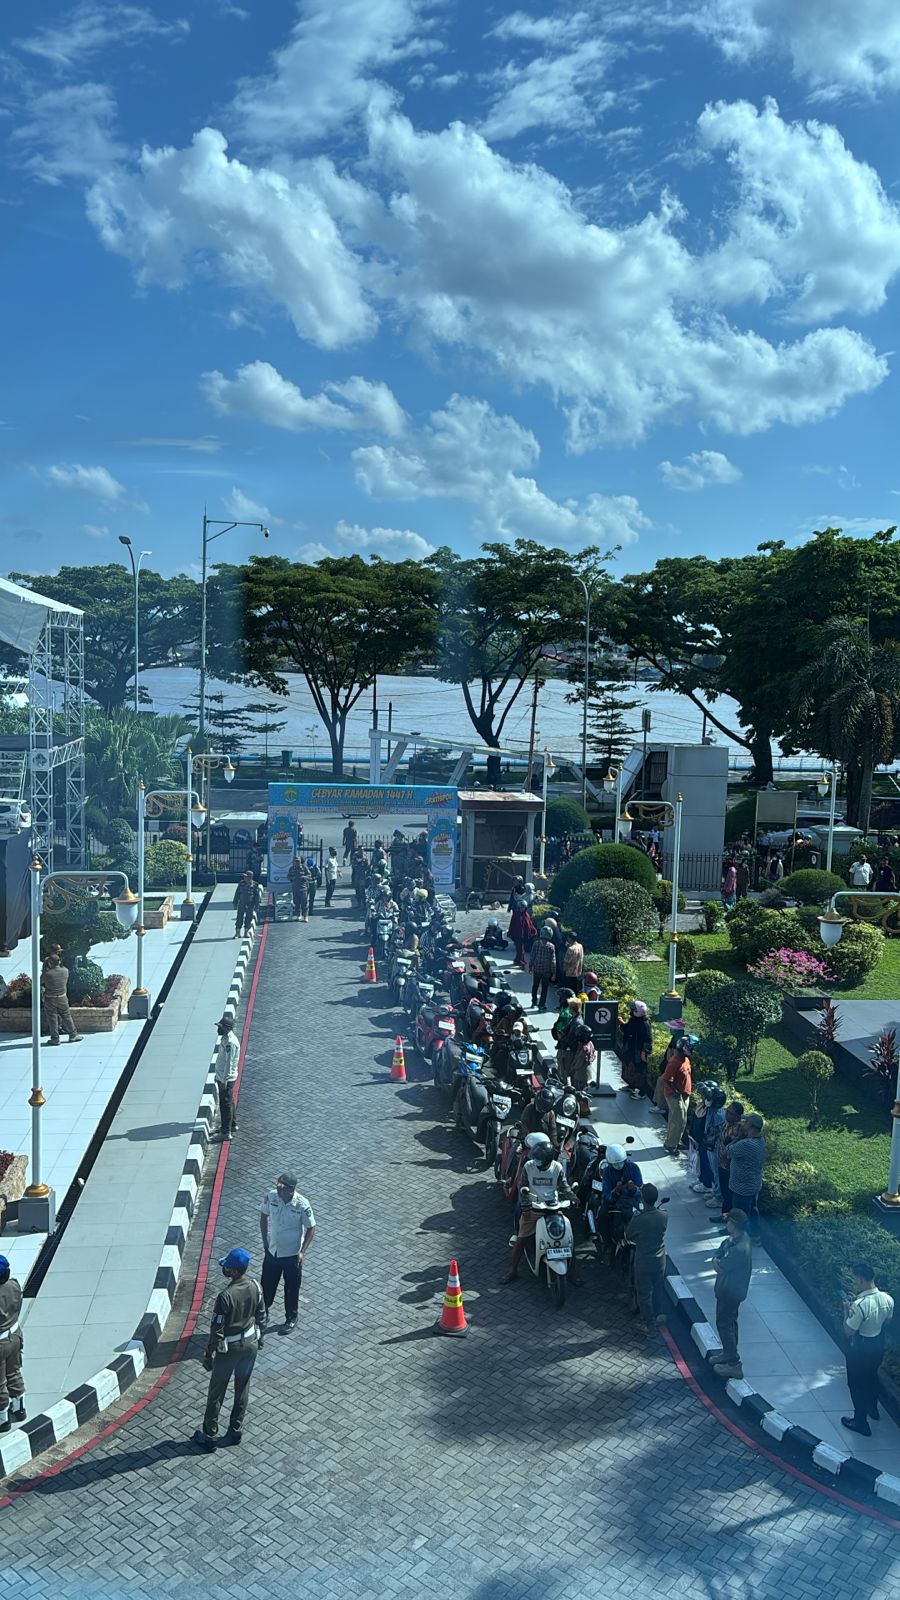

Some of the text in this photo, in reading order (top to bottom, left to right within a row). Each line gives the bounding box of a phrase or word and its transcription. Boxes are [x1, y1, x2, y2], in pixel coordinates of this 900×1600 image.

[312, 788, 342, 798] GEBYAR
[345, 789, 384, 799] RAMADAN
[386, 789, 405, 799] 1447
